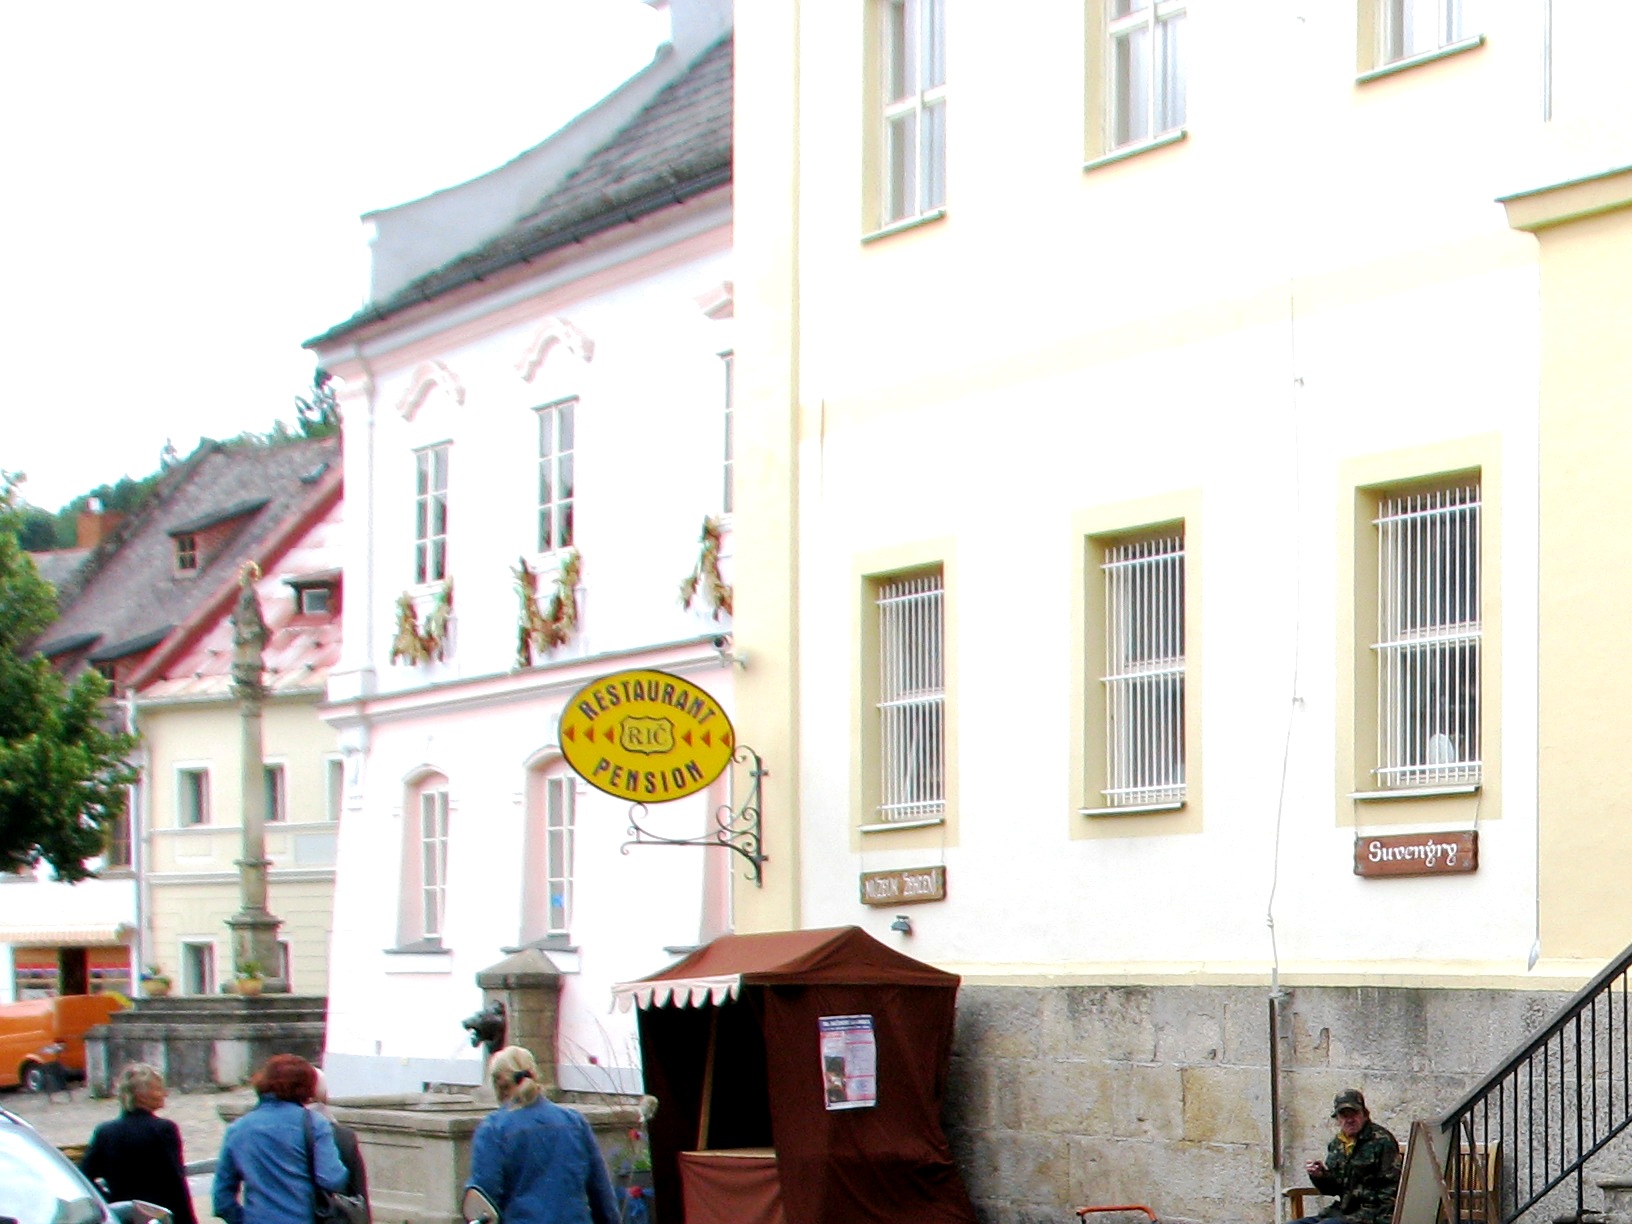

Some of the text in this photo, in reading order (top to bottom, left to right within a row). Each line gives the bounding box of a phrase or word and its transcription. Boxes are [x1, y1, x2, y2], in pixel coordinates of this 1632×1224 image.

[578, 679, 716, 725] RESTAURANT
[627, 722, 668, 746] RIČ
[592, 757, 704, 794] PENSION
[1368, 839, 1458, 867] Suvenýry
